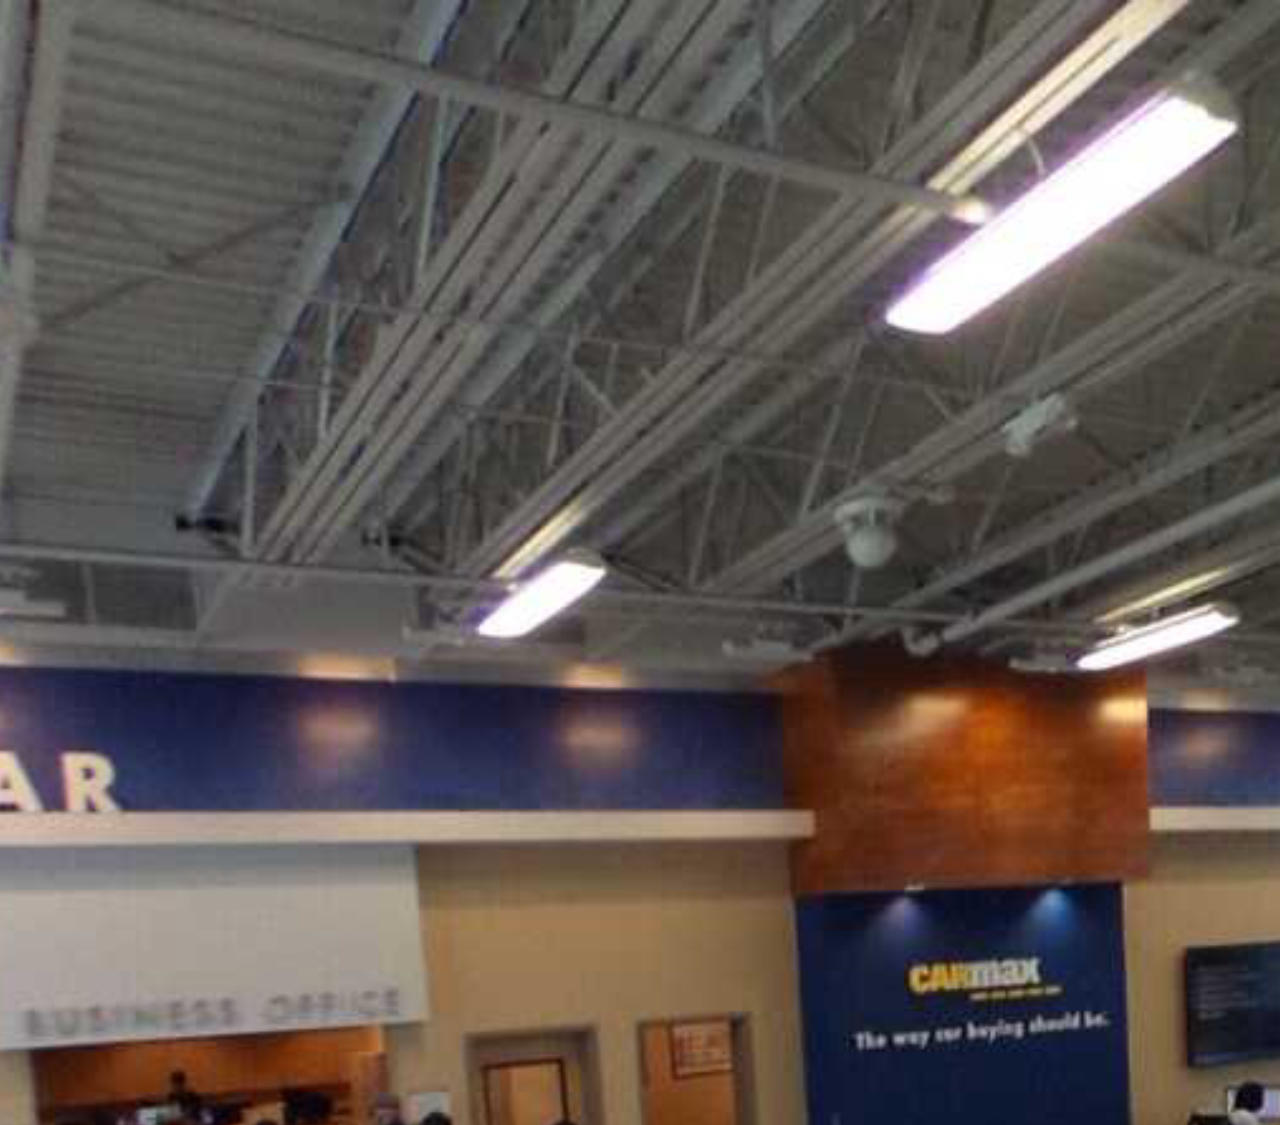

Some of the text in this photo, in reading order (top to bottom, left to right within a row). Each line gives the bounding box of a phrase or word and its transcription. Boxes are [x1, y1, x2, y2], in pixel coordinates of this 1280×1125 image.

[25, 987, 402, 1038] BUSINESS OFFICE
[854, 1031, 887, 1051] The
[893, 1032, 930, 1050] way
[934, 1026, 963, 1042] car
[966, 1020, 1024, 1044] buying
[1029, 1012, 1080, 1034] should
